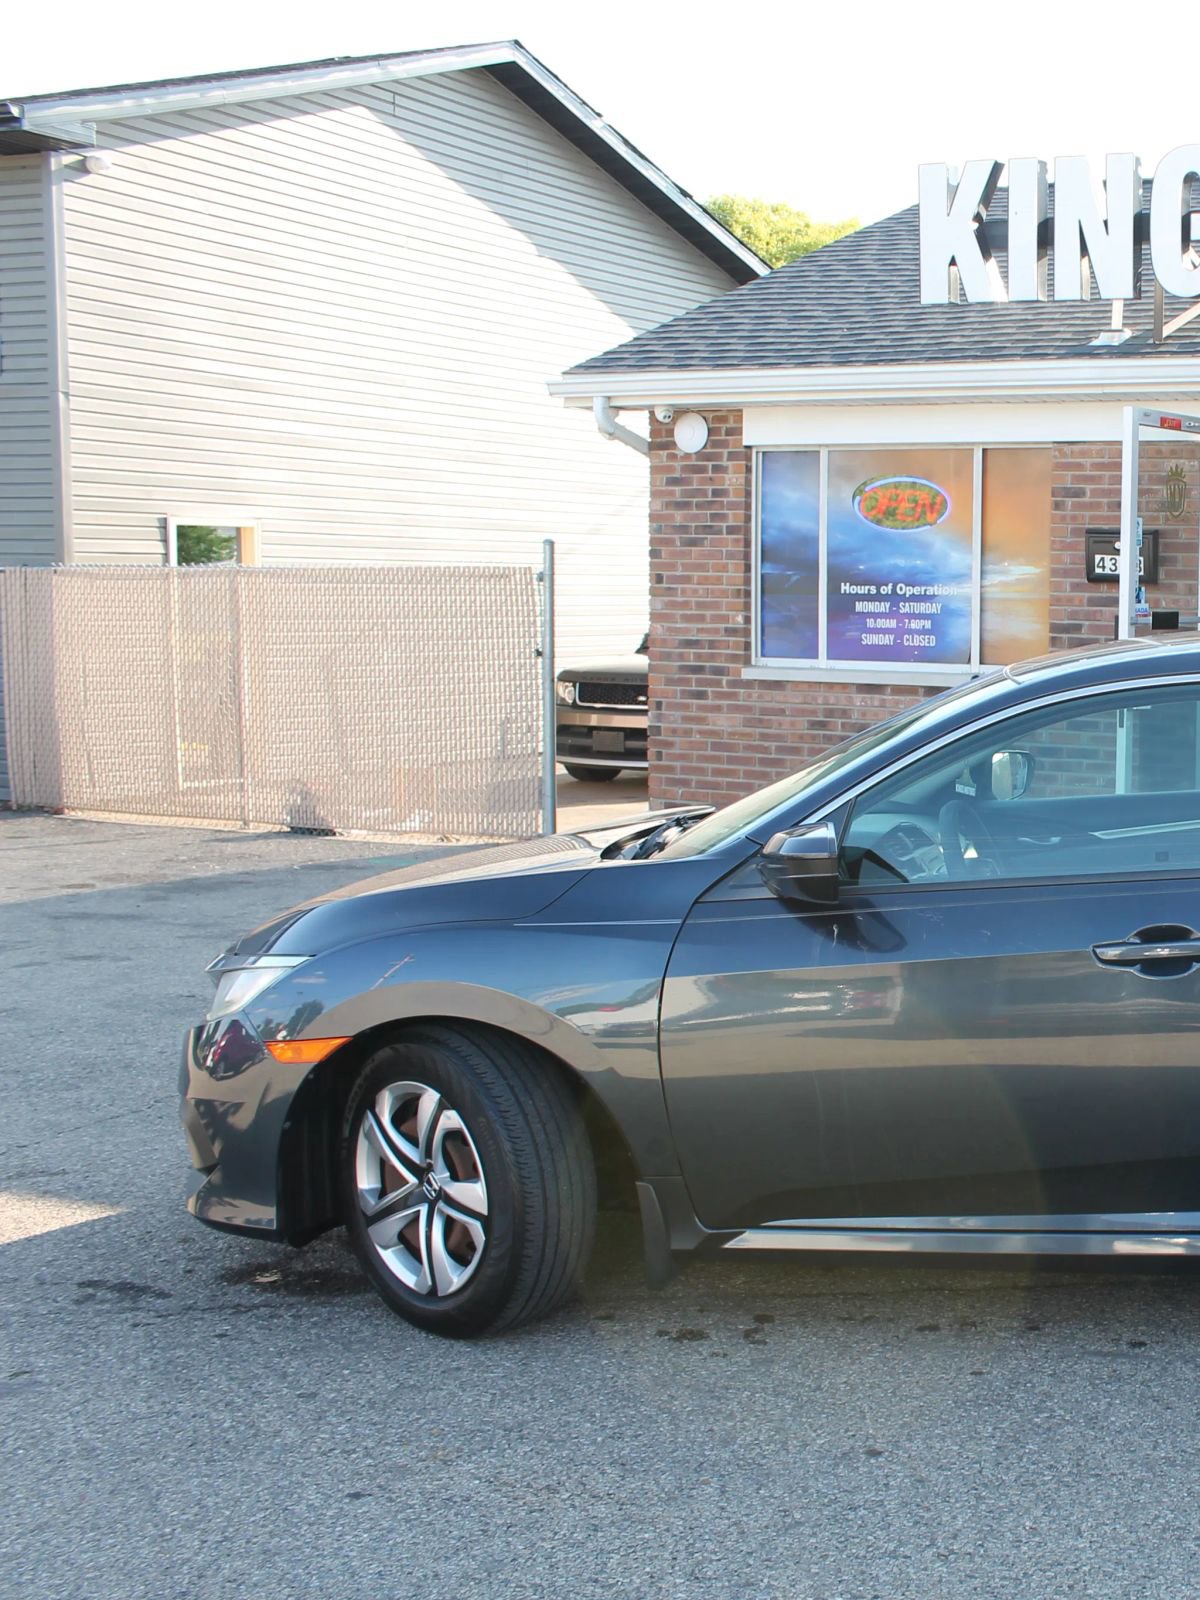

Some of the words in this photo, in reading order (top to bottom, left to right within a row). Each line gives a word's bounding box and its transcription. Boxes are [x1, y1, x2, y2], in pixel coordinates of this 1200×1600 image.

[860, 487, 945, 524] OPEN
[840, 582, 877, 595] Hours
[880, 583, 893, 595] of
[896, 583, 957, 597] Operation
[855, 601, 890, 613] MONDAY
[899, 602, 942, 615] SATURDAY
[861, 633, 895, 646] SUNDAY
[903, 634, 936, 647] CLOSED
